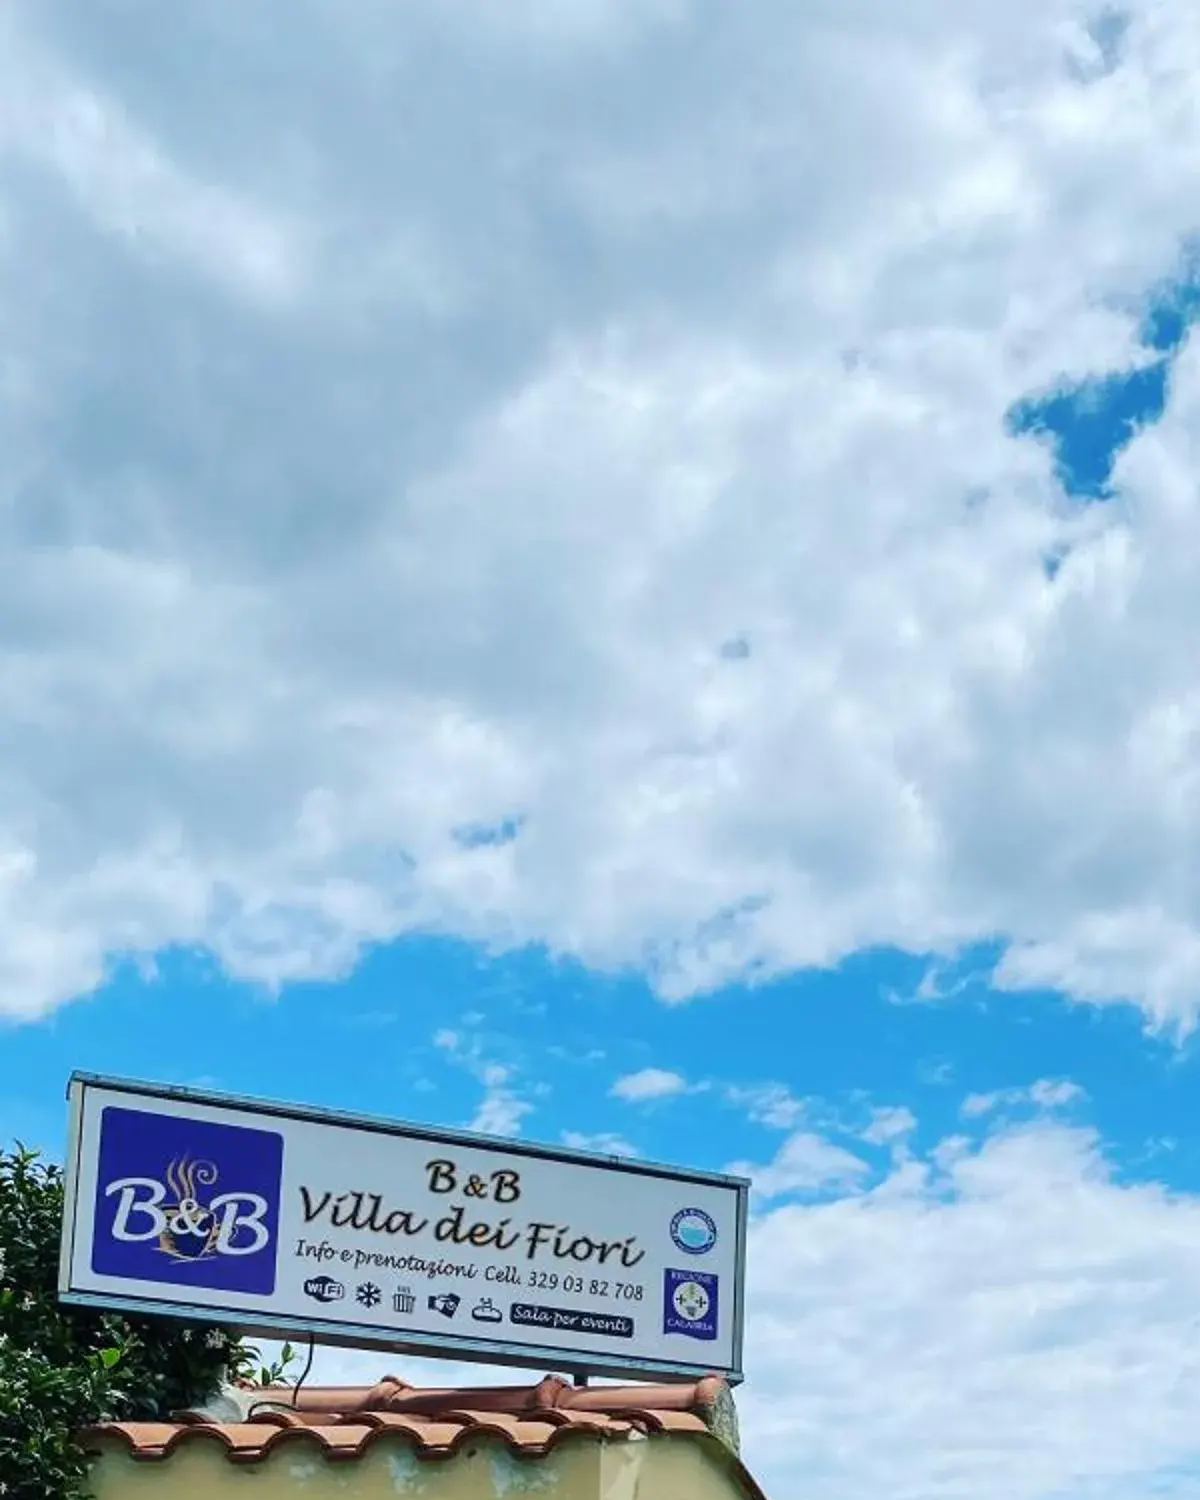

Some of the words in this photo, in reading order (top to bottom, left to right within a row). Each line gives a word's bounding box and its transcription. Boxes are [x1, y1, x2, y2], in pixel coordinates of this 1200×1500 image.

[105, 1177, 270, 1255] B&B
[299, 1185, 428, 1235] Villa
[434, 1205, 520, 1249] dei
[525, 1222, 646, 1267] Fiori
[295, 1239, 336, 1262] Info
[340, 1249, 354, 1263] e
[353, 1249, 479, 1279] prenotazioni
[527, 1270, 559, 1290] 329
[563, 1275, 584, 1293] 03
[589, 1279, 609, 1297] 82
[614, 1283, 644, 1301] 708
[513, 1305, 550, 1321] Sala
[553, 1311, 580, 1327] per
[580, 1316, 630, 1333] eventi
